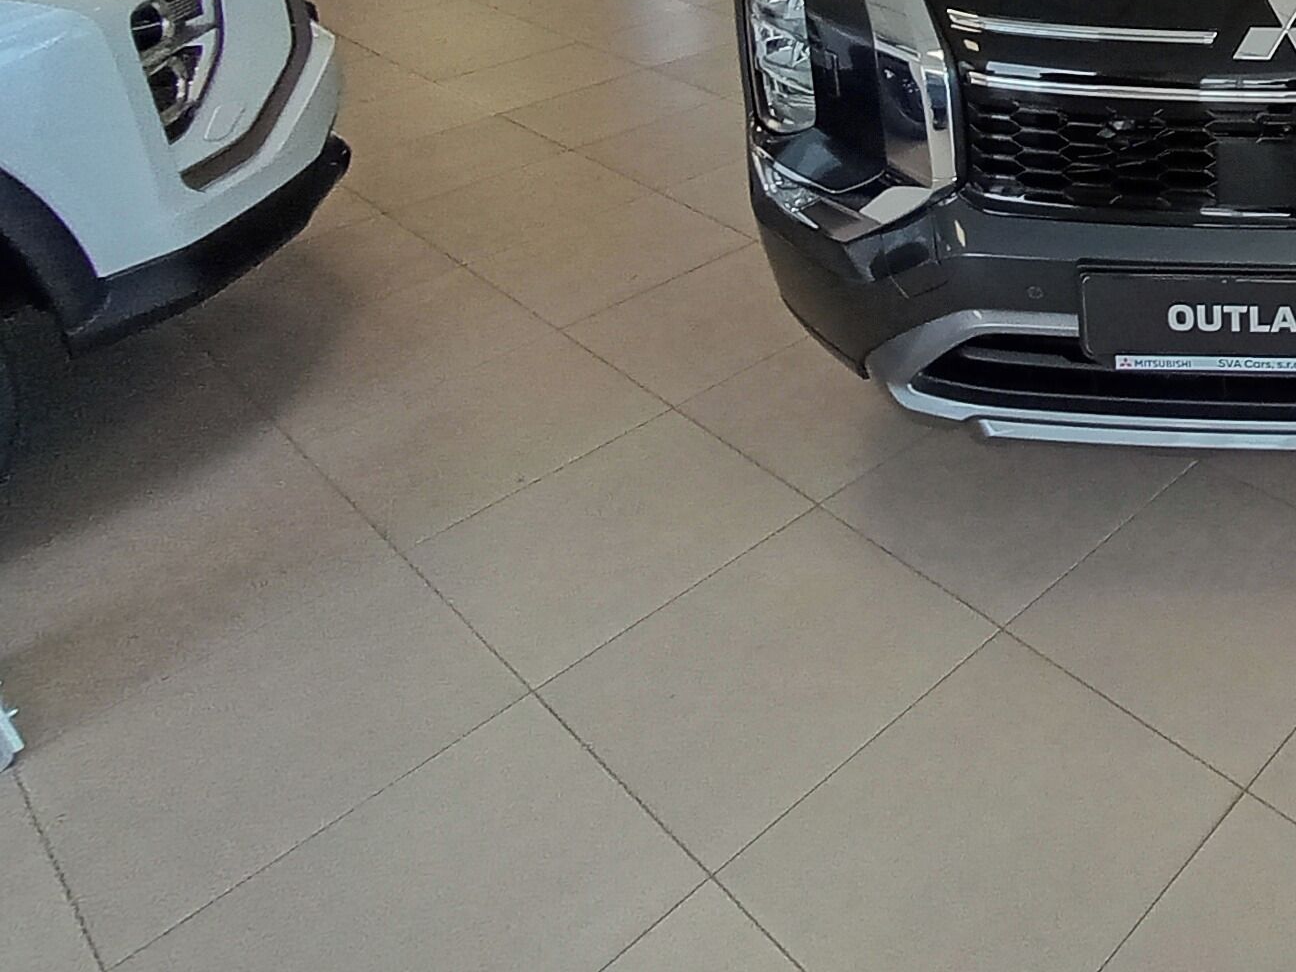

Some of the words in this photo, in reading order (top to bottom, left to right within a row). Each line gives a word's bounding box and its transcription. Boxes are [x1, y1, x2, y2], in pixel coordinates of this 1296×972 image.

[1134, 359, 1192, 369] MITSUBISHI
[1217, 358, 1242, 369] SVA
[1244, 359, 1275, 371] Cars,
